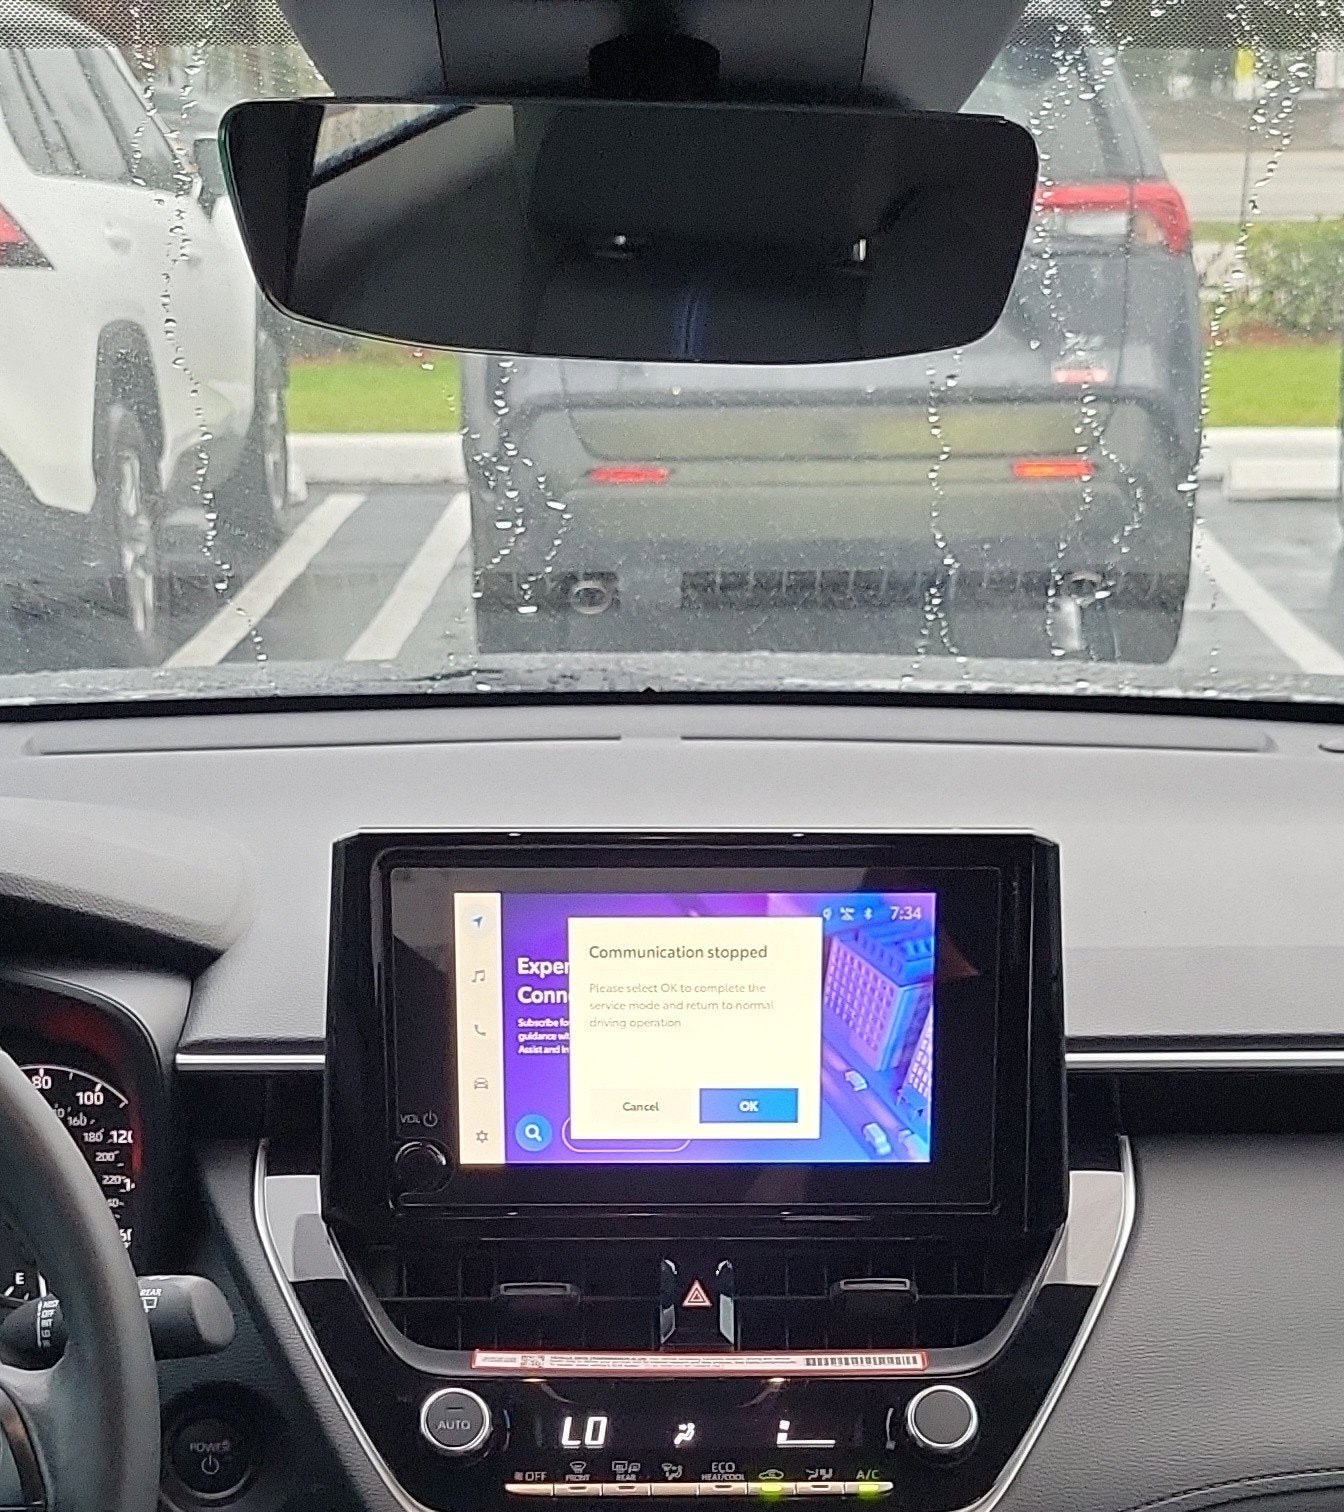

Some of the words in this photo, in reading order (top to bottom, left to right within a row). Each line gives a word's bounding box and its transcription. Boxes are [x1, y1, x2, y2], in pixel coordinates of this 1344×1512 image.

[889, 905, 922, 920] 7:34
[589, 945, 704, 959] Communication
[707, 944, 768, 961] stopped
[589, 983, 624, 993] Please
[626, 983, 657, 993] select
[660, 983, 677, 993] OK
[680, 984, 692, 993] to
[694, 983, 746, 994] complete
[748, 983, 766, 993] the
[589, 1001, 626, 1010] service
[628, 1000, 660, 1010] mode
[662, 1001, 684, 1010] and
[686, 1002, 718, 1010] return
[722, 1001, 733, 1010] to
[735, 1000, 774, 1010] normal
[517, 1017, 559, 1027] Subscribe
[589, 1018, 627, 1029] driving
[517, 1031, 557, 1042] guidance
[31, 1075, 52, 1090] 80
[75, 1091, 104, 1106] 100
[622, 1101, 660, 1112] Cancel
[739, 1100, 759, 1112] OK
[67, 1115, 87, 1127] 160
[399, 1113, 421, 1124] VOL
[82, 1131, 103, 1143] 180
[94, 1151, 115, 1162] 200
[15, 1272, 25, 1285] E
[139, 1288, 162, 1297] REAR
[437, 1419, 472, 1431] AUTO
[711, 1461, 736, 1473] ECO
[525, 1471, 548, 1482] OFF
[856, 1469, 880, 1480] A/C
